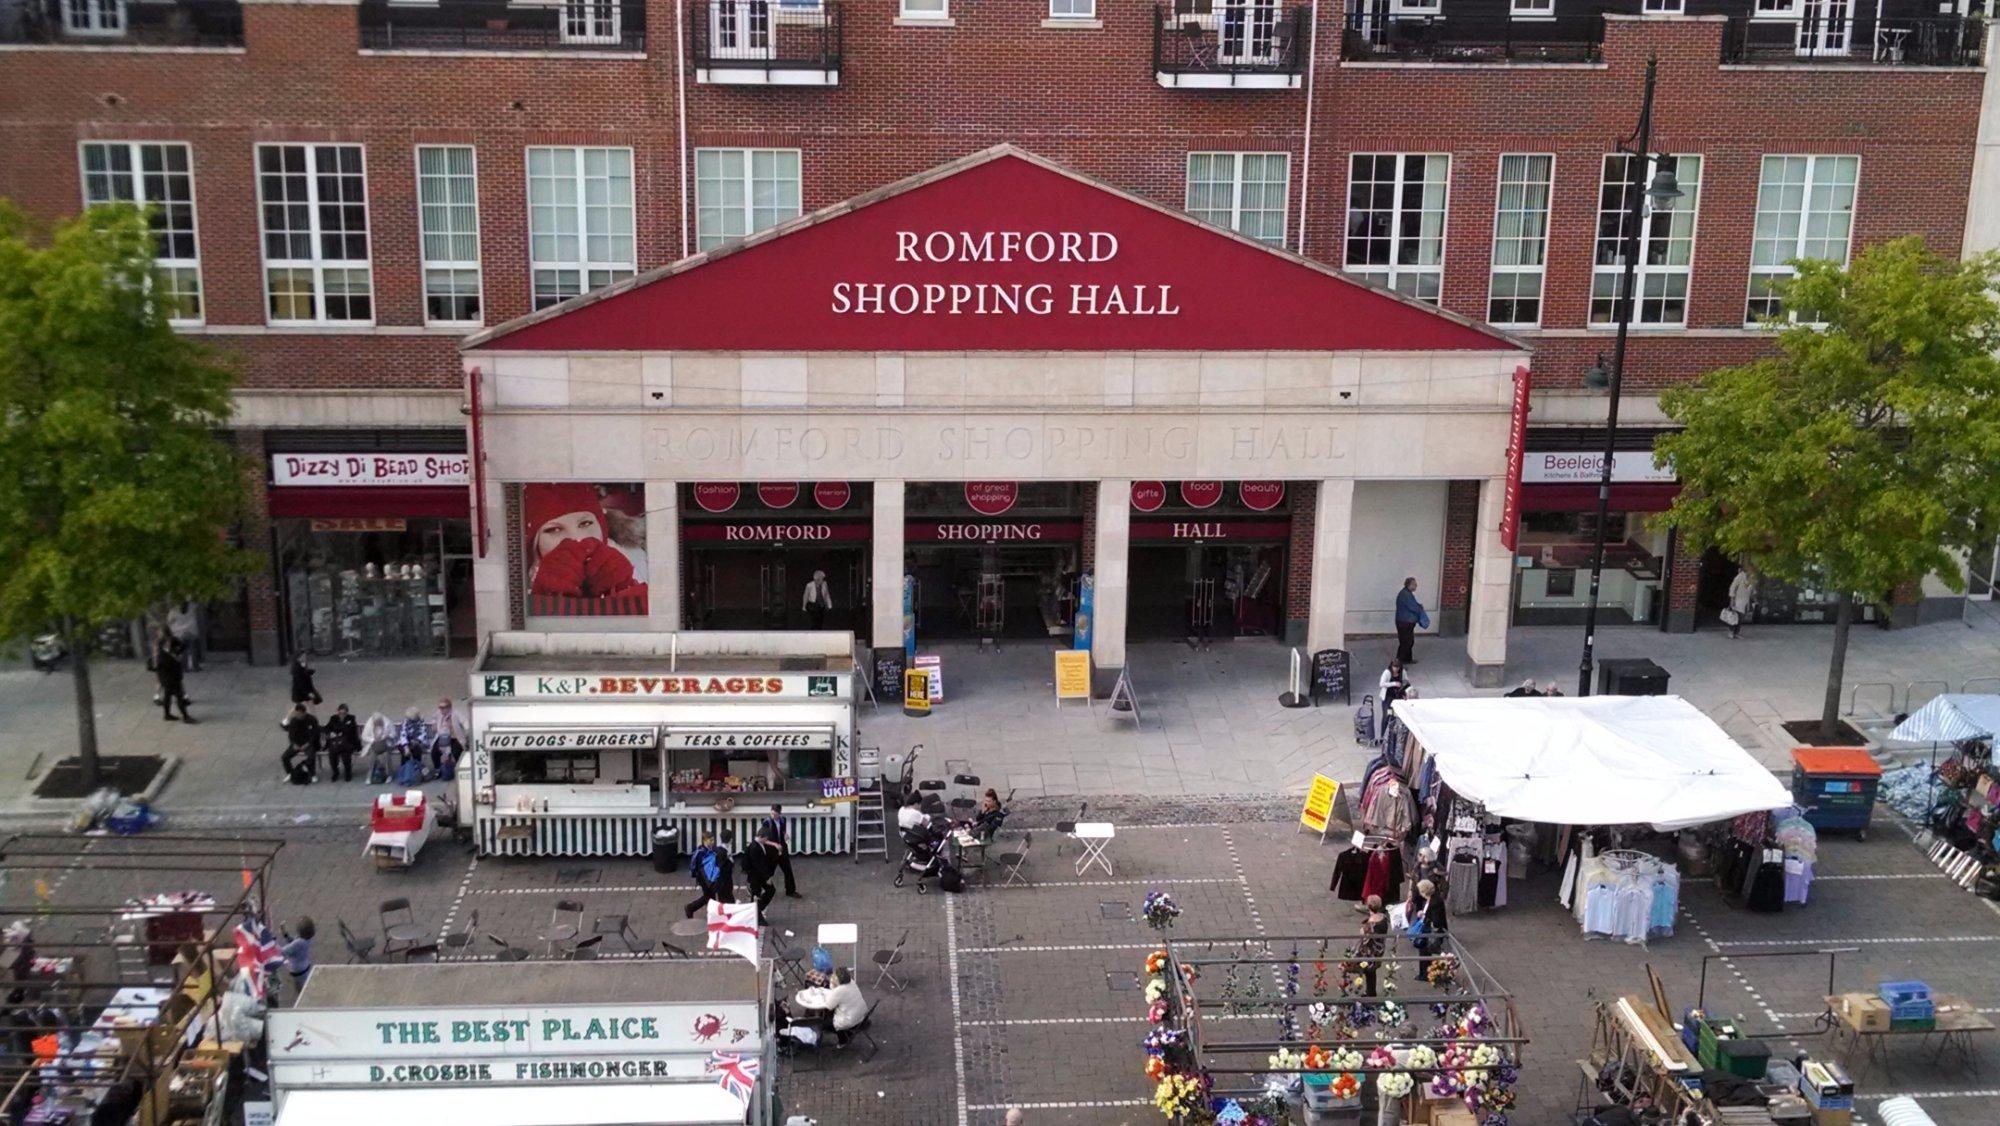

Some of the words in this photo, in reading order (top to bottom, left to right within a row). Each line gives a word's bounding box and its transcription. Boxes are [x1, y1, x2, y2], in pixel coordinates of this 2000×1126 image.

[895, 230, 1118, 263] ROMFORD
[831, 282, 1054, 315] SHOPPING
[1069, 284, 1180, 315] HALL
[1508, 377, 1523, 481] SHOPPING
[652, 427, 905, 461] ROMFORD
[938, 426, 1192, 461] SHOPPING
[1229, 426, 1346, 461] HALL
[346, 457, 366, 478] Di
[698, 485, 736, 495] fashion
[972, 484, 984, 492] of
[985, 484, 1010, 493] great
[1190, 481, 1215, 491] food
[1244, 483, 1280, 494] beauty
[971, 493, 1011, 503] shopping
[1136, 489, 1159, 500] gifts
[1503, 486, 1514, 534] HALL
[725, 525, 832, 541] ROMFORD
[937, 524, 1042, 540] SHOPPING
[1173, 523, 1227, 538] HALL
[488, 679, 510, 692] 45
[490, 735, 520, 747] HOT
[524, 734, 566, 747] DOGS
[576, 734, 648, 746] BURGERS
[684, 735, 722, 746] TEAS
[726, 735, 737, 746] &
[743, 734, 810, 746] COFFEES
[822, 778, 844, 788] VOTE
[823, 786, 856, 798] UKIP
[376, 1020, 441, 1044] THE
[451, 1019, 531, 1043] BEST
[542, 1017, 660, 1041] PLAICE
[369, 1063, 493, 1083] D.CROSBIE
[515, 1060, 669, 1080] FISHMONGER
